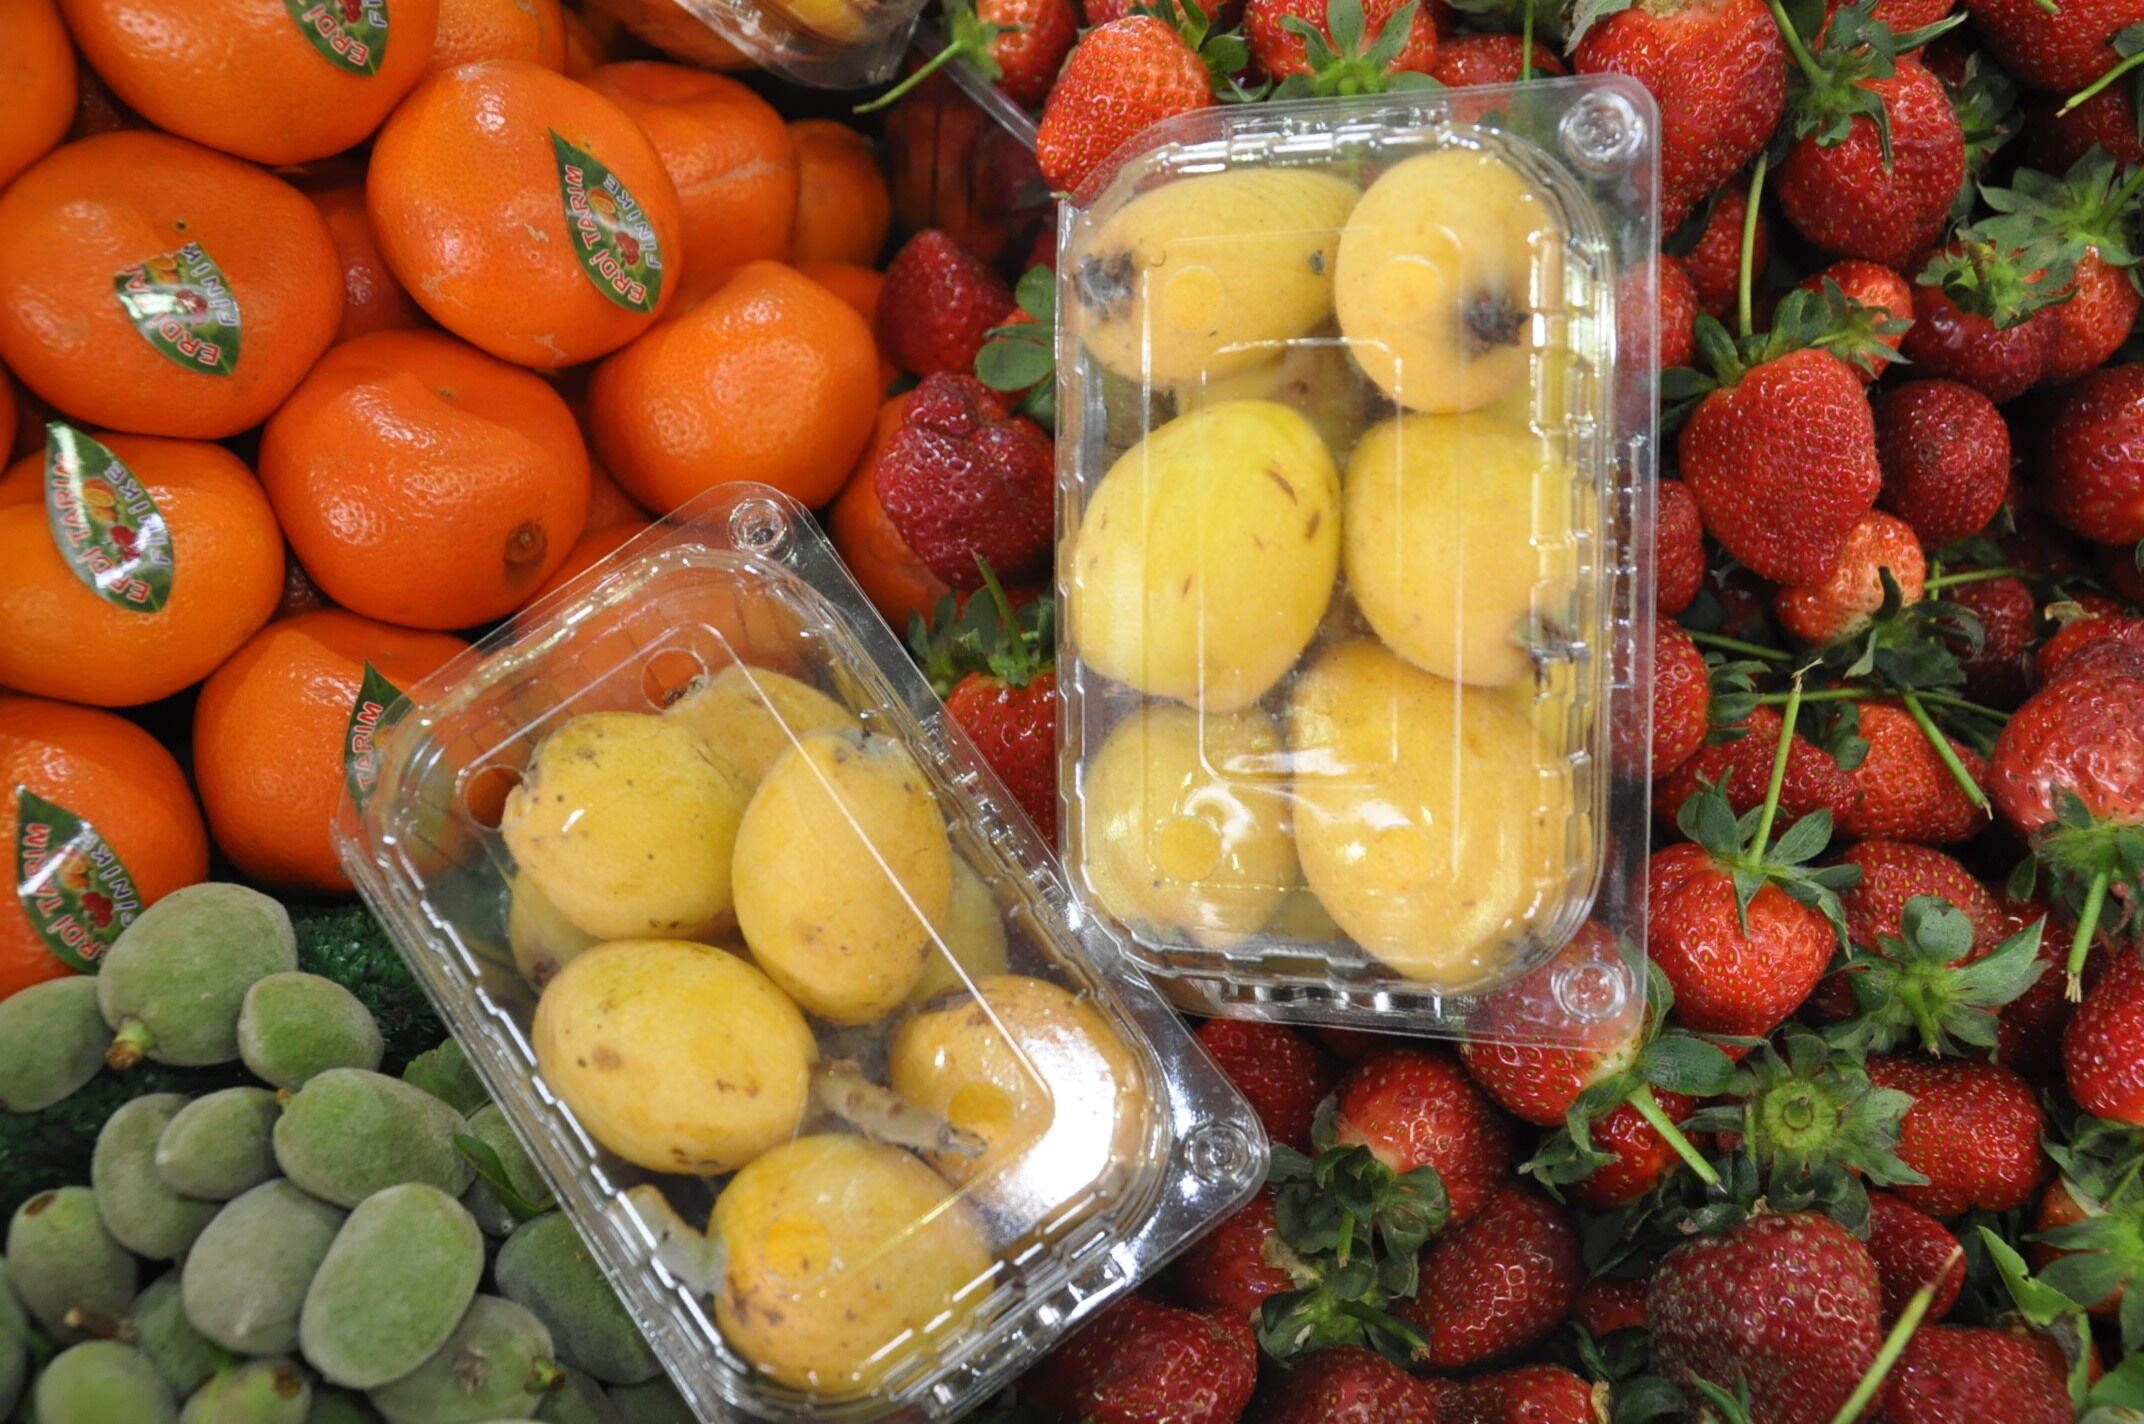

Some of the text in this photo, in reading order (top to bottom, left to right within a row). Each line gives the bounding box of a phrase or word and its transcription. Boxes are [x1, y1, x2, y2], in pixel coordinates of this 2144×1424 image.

[564, 164, 648, 304] ERDİ TARIM
[353, 701, 384, 791] TARIM
[46, 913, 111, 962] RDİ
